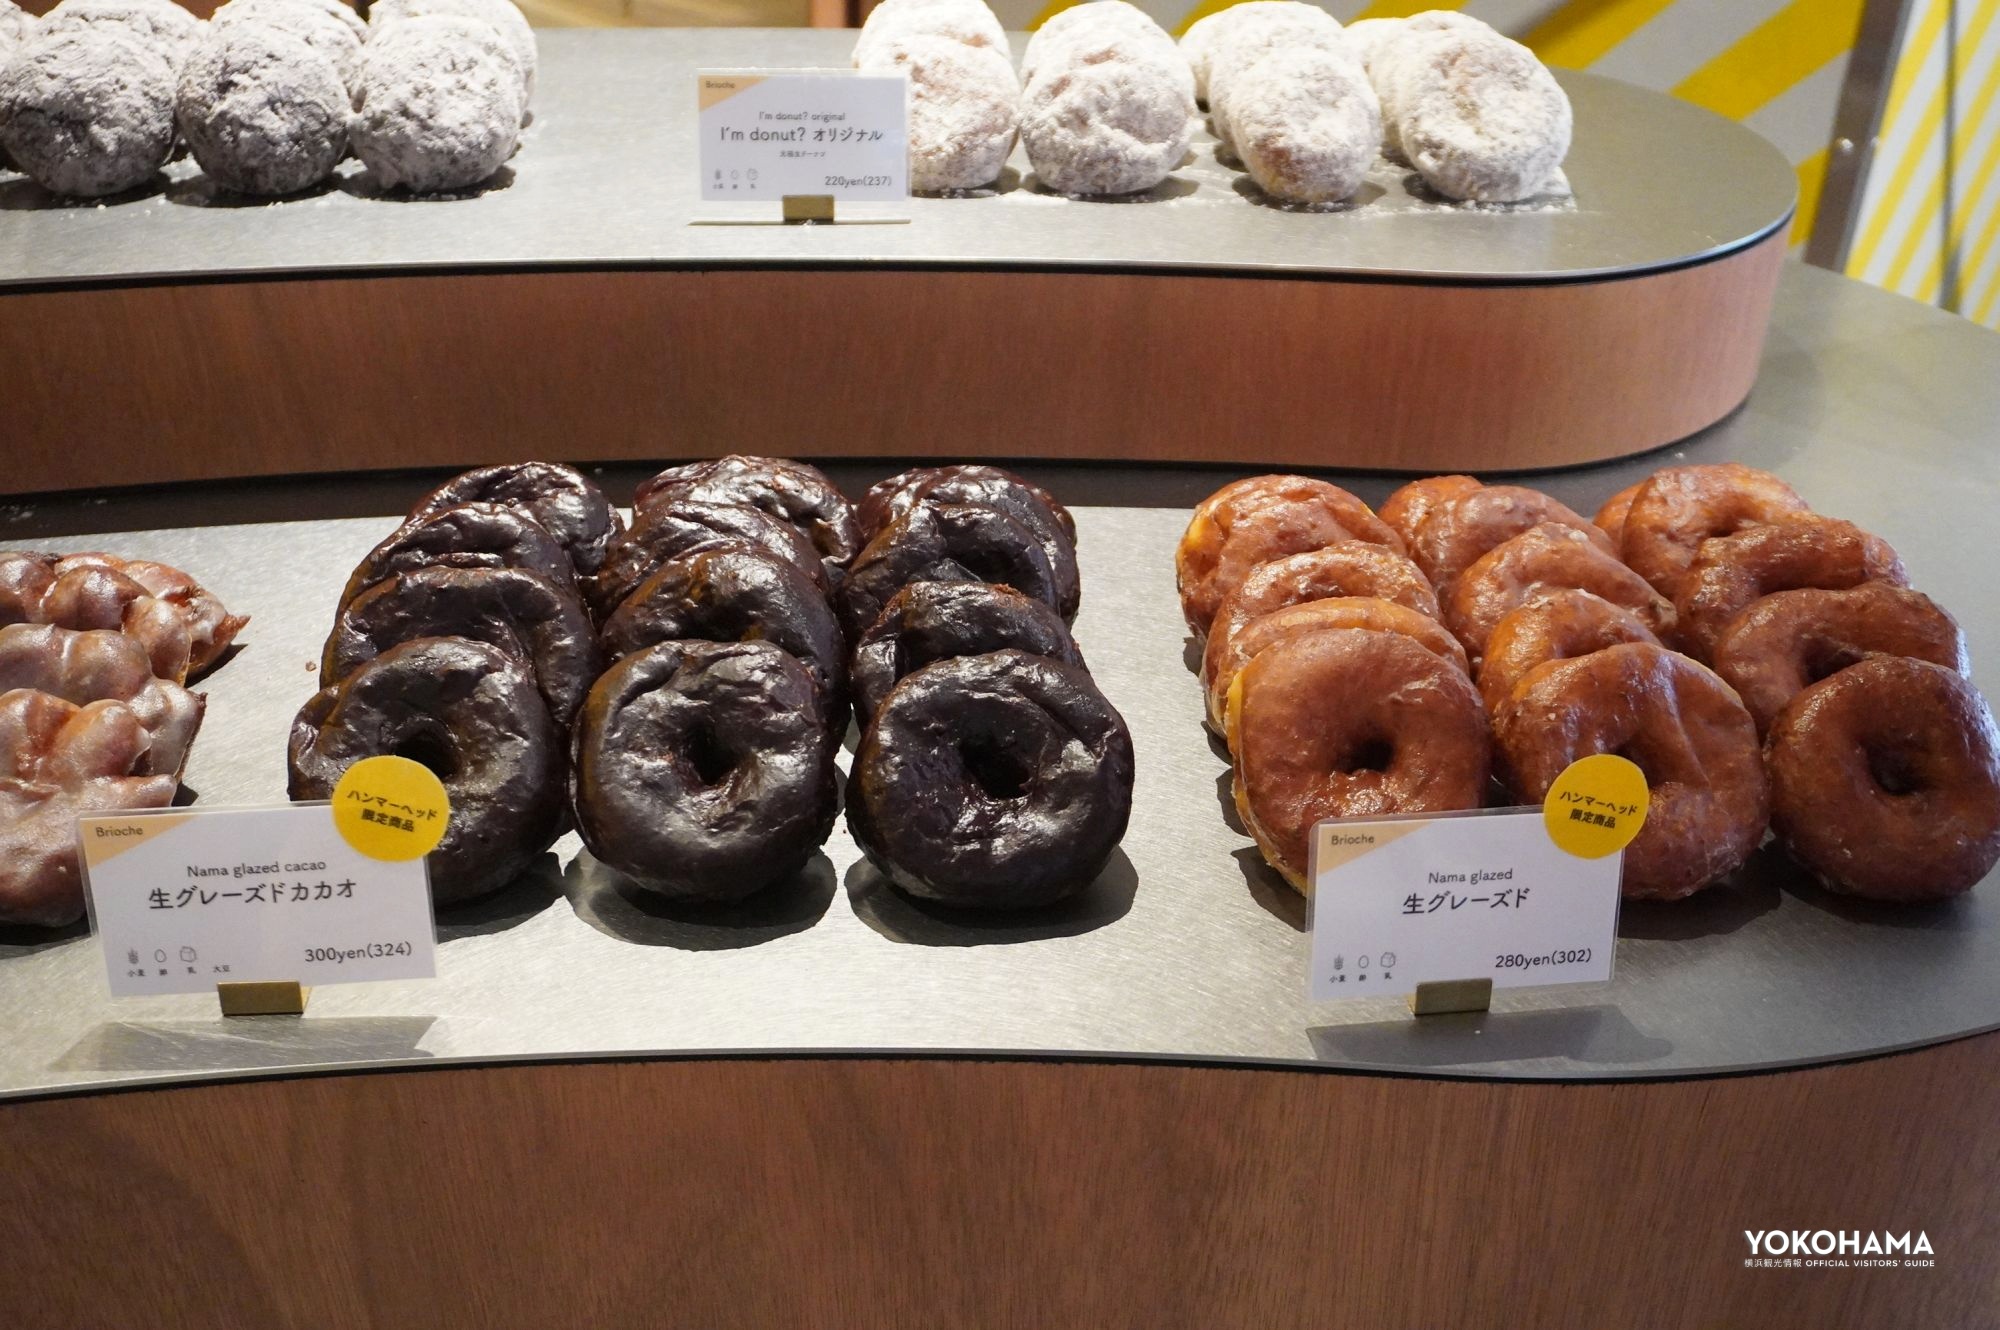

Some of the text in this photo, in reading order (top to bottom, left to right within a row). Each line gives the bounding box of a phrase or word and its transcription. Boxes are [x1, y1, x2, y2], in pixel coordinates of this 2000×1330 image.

[775, 111, 808, 121] donut?
[811, 111, 846, 123] original
[749, 126, 806, 142] donut?
[812, 126, 884, 143] オリジナル
[824, 175, 892, 189] 220yen(237)
[346, 789, 438, 822] ハンマーヘッド
[1559, 790, 1638, 817] ハンマーヘッド
[360, 809, 416, 833] 限定商品
[1569, 809, 1616, 830] 限定商品
[95, 825, 144, 838] Brioche
[1331, 834, 1375, 846] Brioche
[187, 861, 326, 880] Nama glazed cacao
[1428, 868, 1513, 886] Nama glazed
[148, 879, 357, 910] 生グレーズドカカオ
[1402, 888, 1531, 915] 生グレーズド
[304, 941, 412, 964] 300yen(324)
[1495, 948, 1592, 970] 280yen(302)
